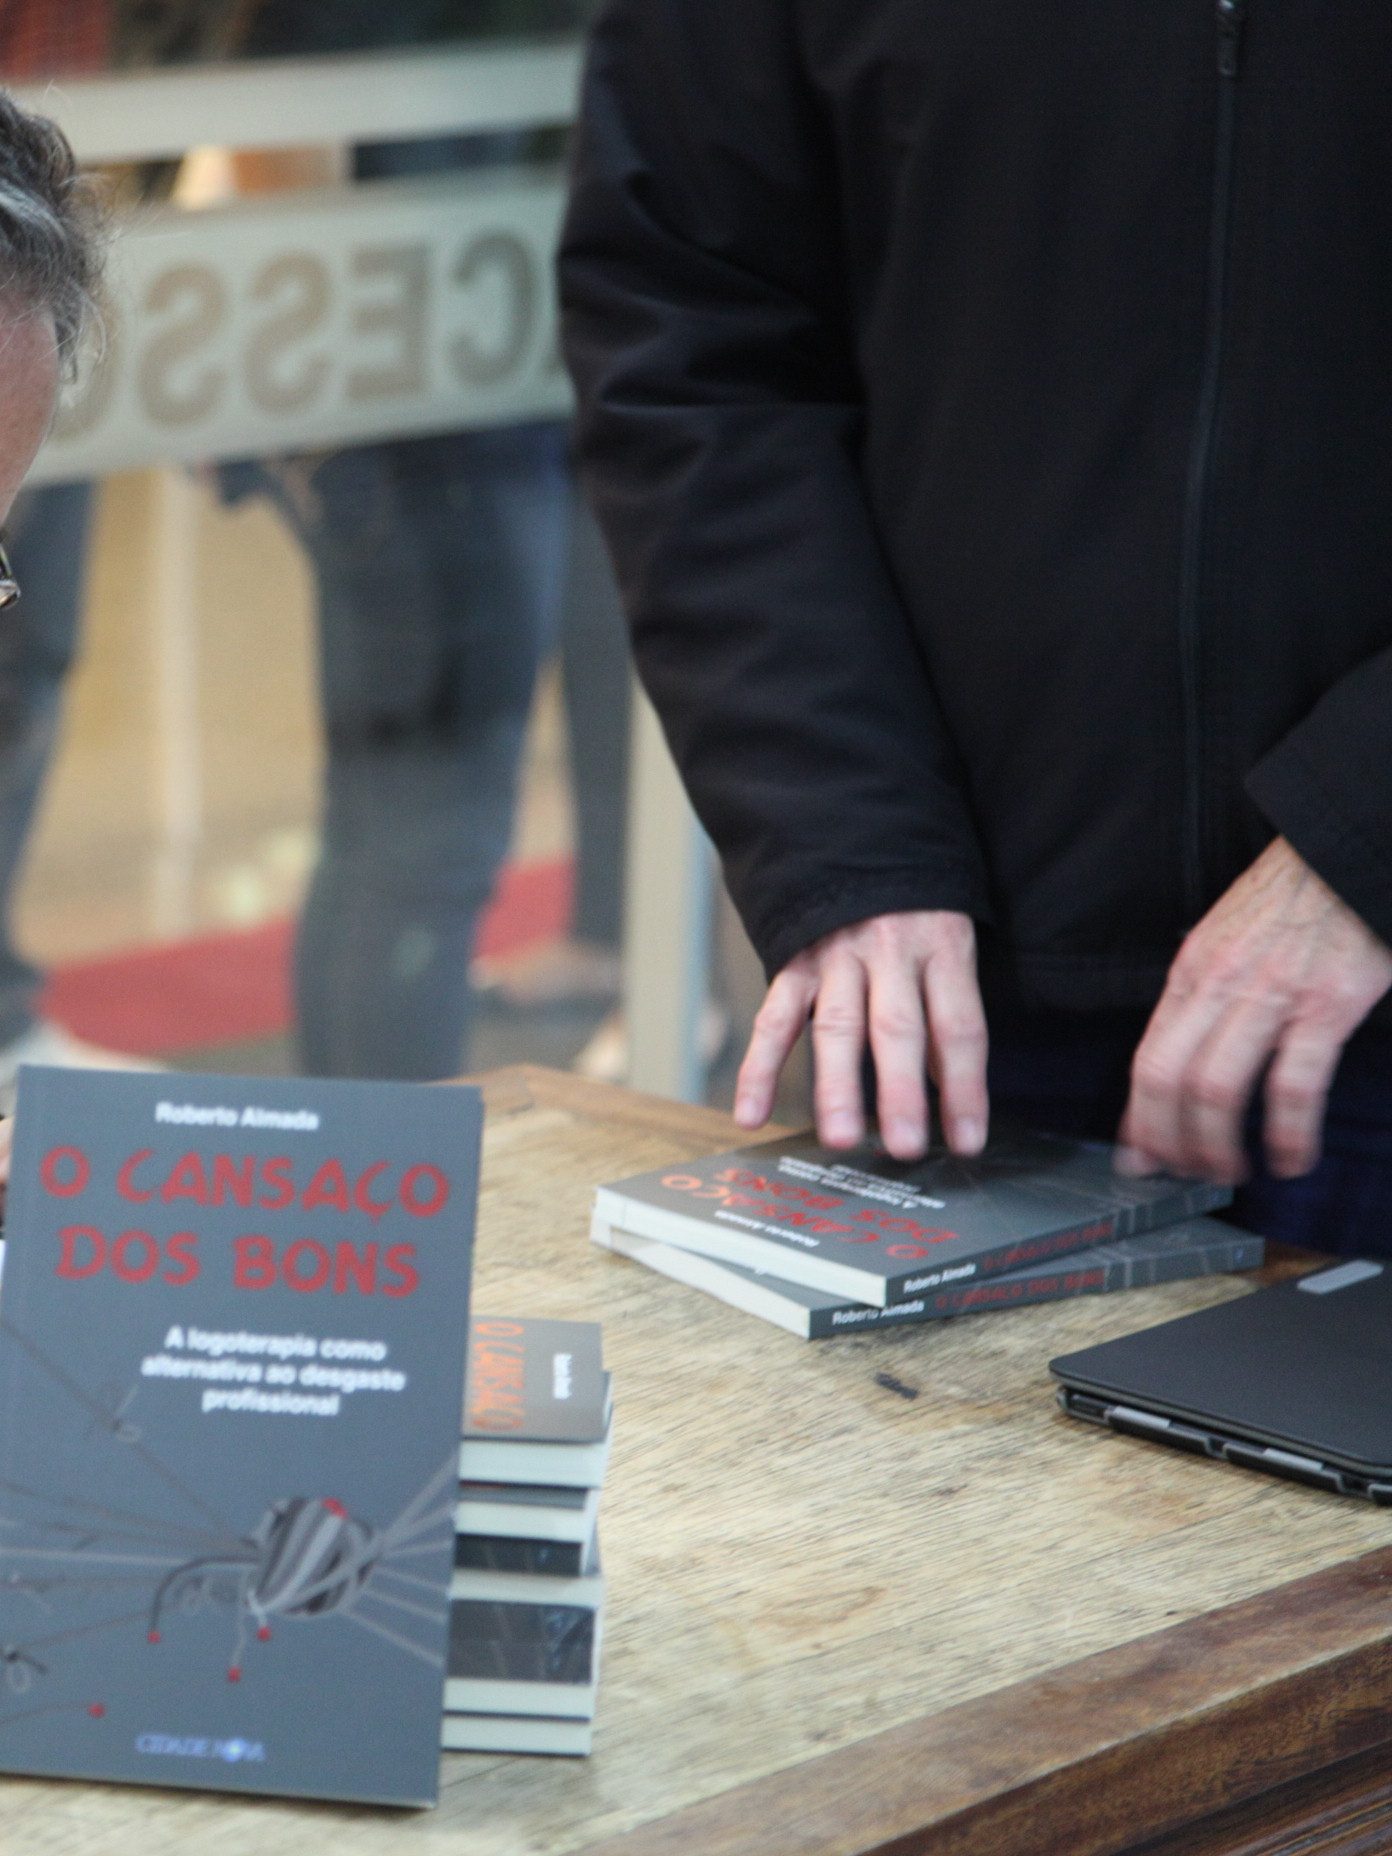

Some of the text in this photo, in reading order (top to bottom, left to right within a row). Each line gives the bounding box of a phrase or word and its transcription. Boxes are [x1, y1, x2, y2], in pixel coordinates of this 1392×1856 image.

[155, 1102, 320, 1131] Roberto Almada
[40, 1145, 450, 1226] O CANSAÇO
[55, 1225, 420, 1298] DOS BONS
[832, 1307, 880, 1327] Roberto
[164, 1325, 388, 1361] A logoterapia como
[141, 1353, 406, 1393] alternativa ao desgaste
[202, 1386, 340, 1416] profissional
